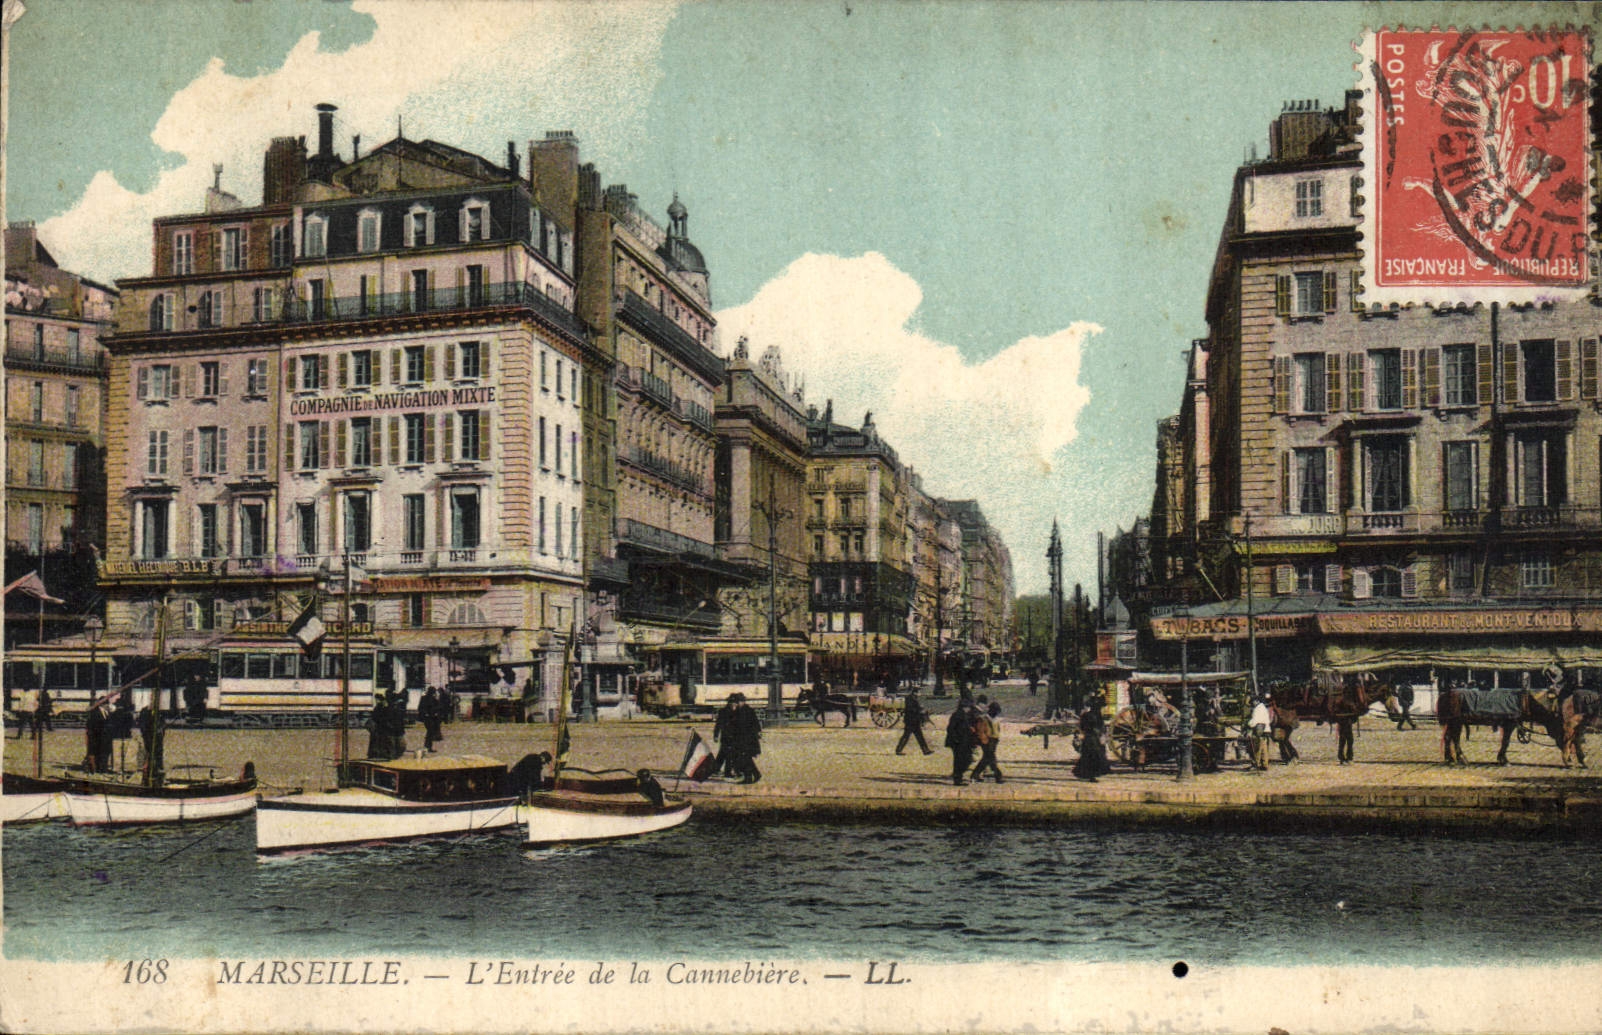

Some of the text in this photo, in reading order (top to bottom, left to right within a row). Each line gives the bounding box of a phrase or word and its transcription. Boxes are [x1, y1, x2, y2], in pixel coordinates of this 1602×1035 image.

[1386, 43, 1405, 126] POSTES
[1385, 257, 1466, 277] FRANÇAISE
[290, 395, 362, 416] COMPAGNIE
[374, 389, 449, 410] NAVIGATION
[452, 386, 496, 405] MIXTE
[1161, 618, 1240, 635] TBACS
[1368, 613, 1458, 629] RESTAURANT
